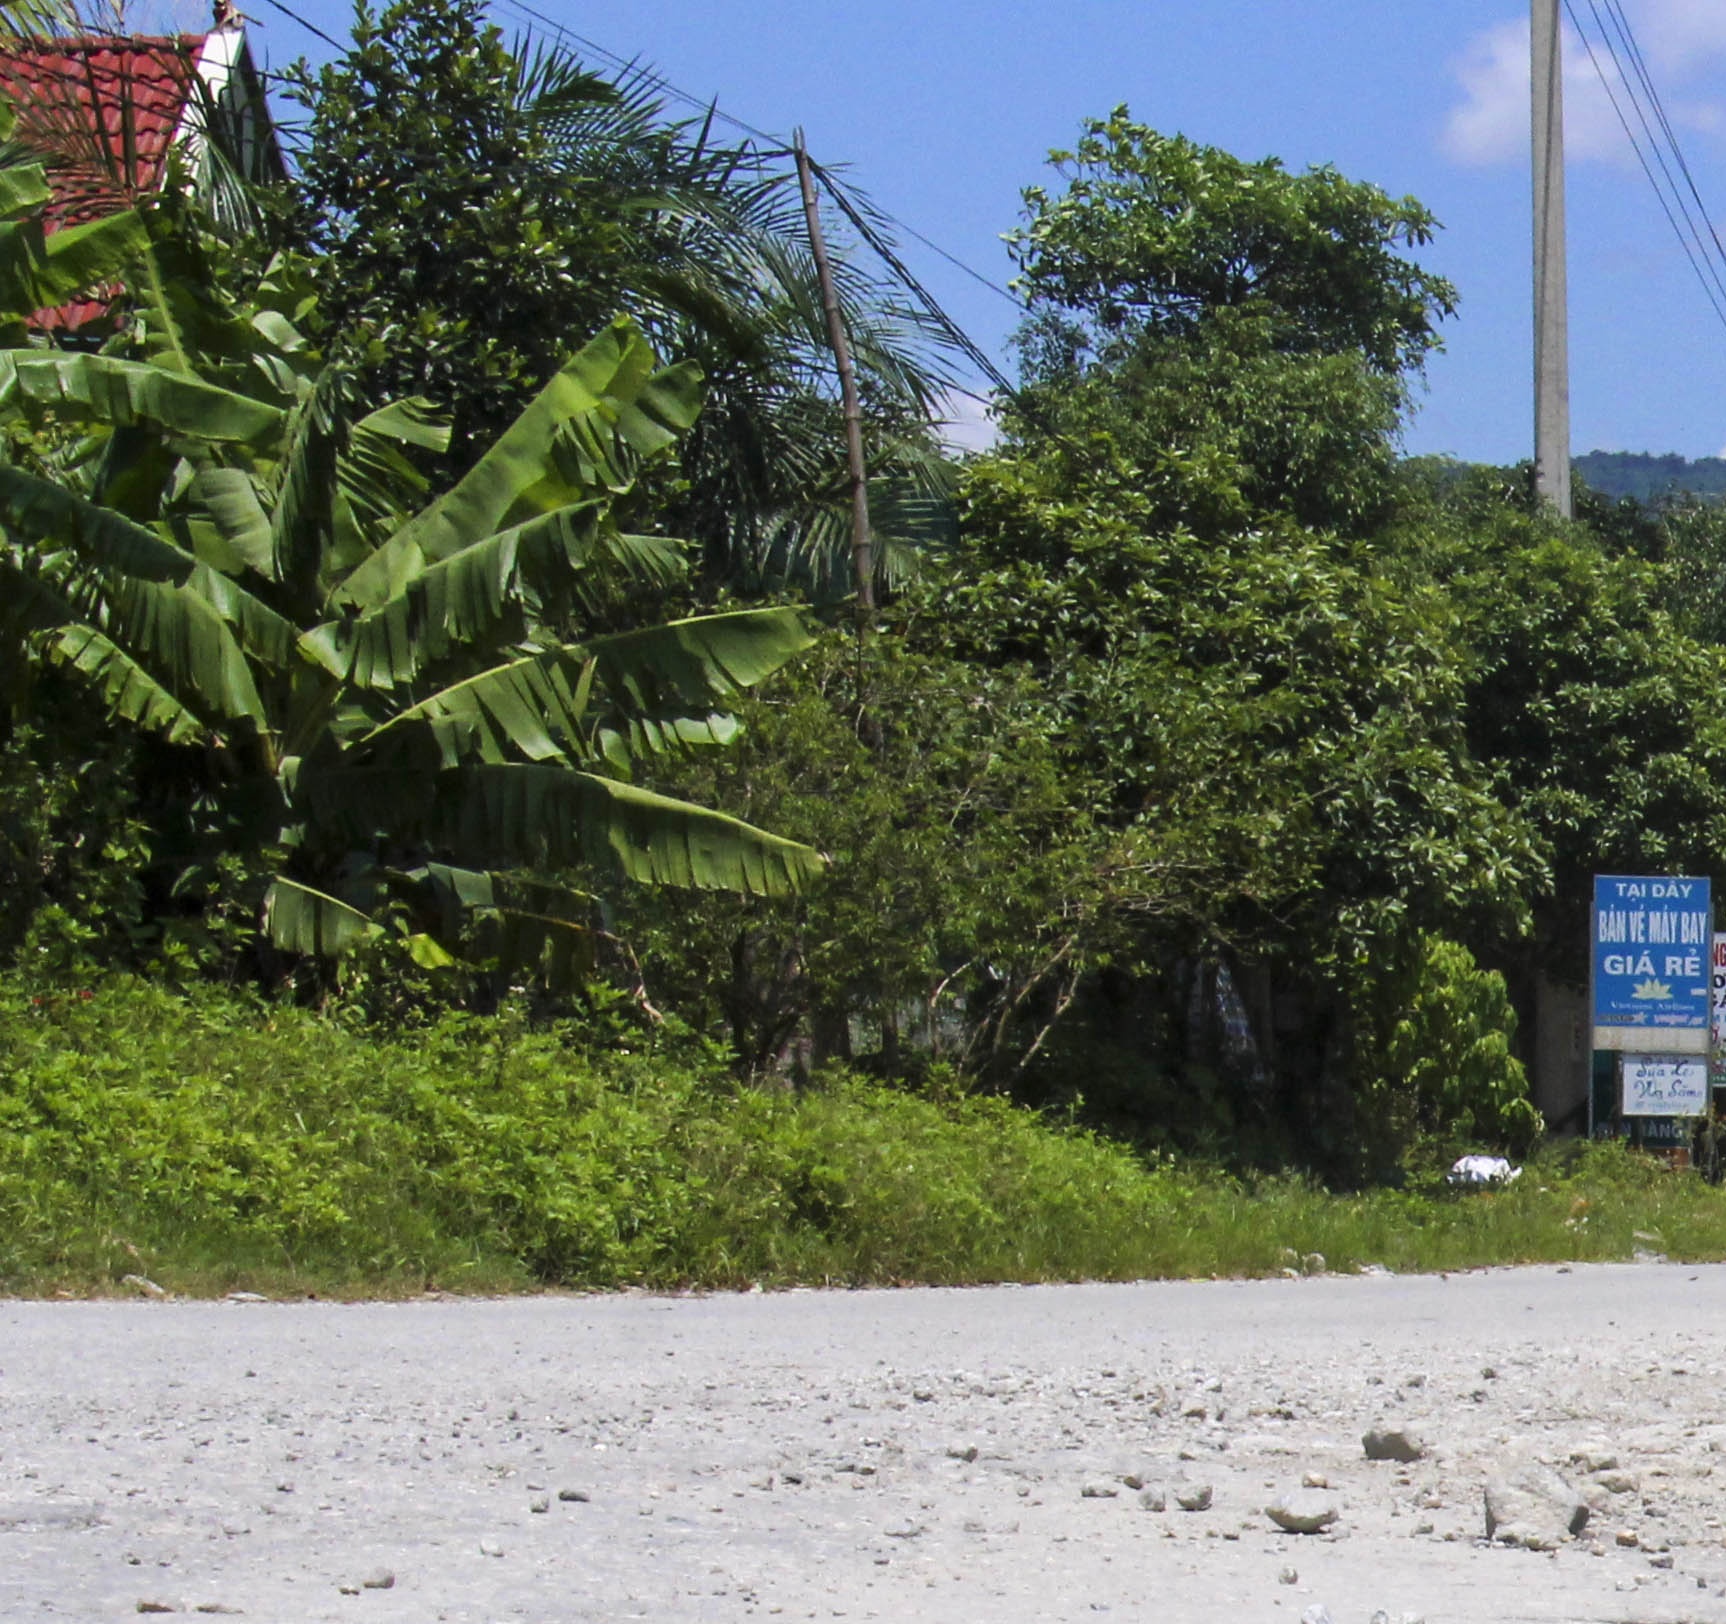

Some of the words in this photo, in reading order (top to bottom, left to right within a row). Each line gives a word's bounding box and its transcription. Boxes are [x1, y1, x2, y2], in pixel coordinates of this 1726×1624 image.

[1615, 883, 1646, 902] TẠI
[1652, 880, 1692, 898] ĐÂY
[1598, 904, 1626, 943] BÁN
[1629, 904, 1645, 943] VÉ
[1649, 904, 1678, 944] MÁY
[1681, 911, 1707, 944] BAY
[1603, 949, 1656, 976] GIÁ
[1665, 948, 1701, 977] RẺ
